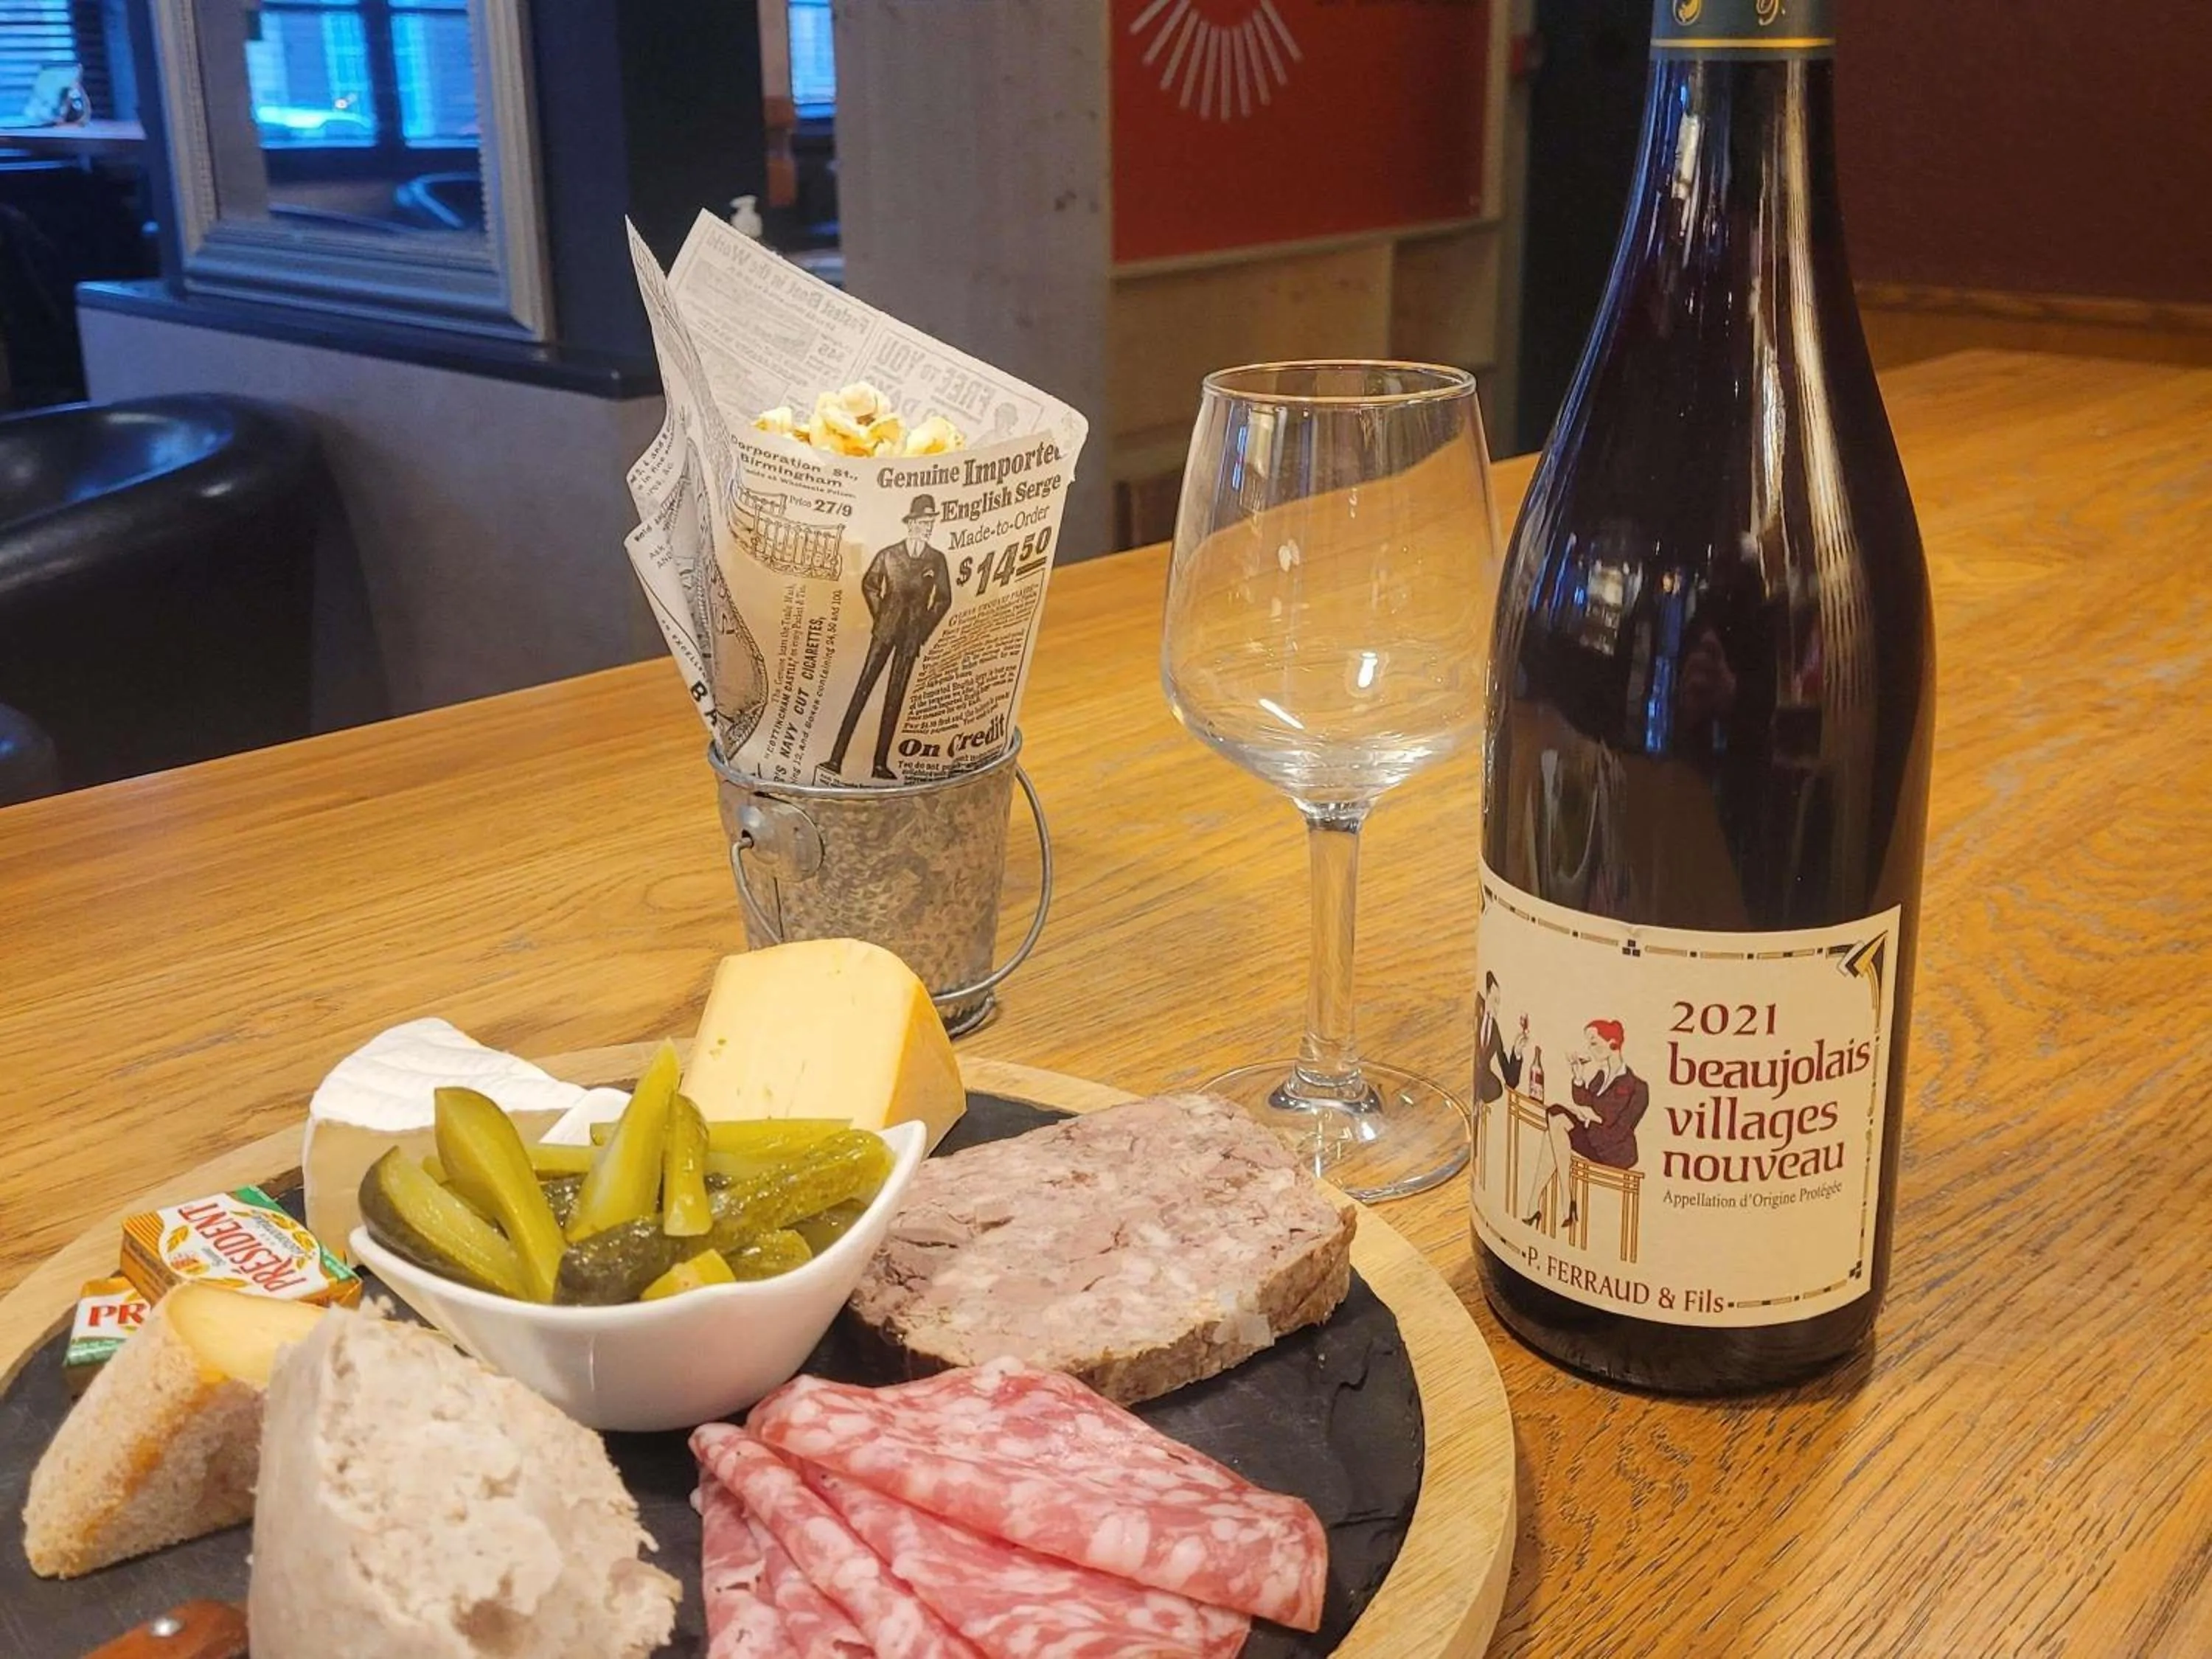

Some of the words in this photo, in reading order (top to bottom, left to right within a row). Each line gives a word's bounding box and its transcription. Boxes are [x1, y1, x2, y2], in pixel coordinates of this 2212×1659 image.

[740, 452, 843, 487] Birmingham
[877, 464, 960, 489] Genuine
[813, 498, 853, 518] 27/9
[940, 485, 1014, 524] English
[1015, 473, 1062, 505] Serge
[947, 505, 1051, 551] Made-to-Order
[801, 616, 827, 681] CIGARETTES,
[793, 686, 810, 715] CUT
[779, 722, 798, 759] NAVY
[897, 738, 942, 758] On
[947, 712, 1006, 759] Credit
[1668, 1000, 1778, 1037] 2021
[1666, 1037, 1872, 1102] beaujolais
[1663, 1094, 1840, 1153] villages
[1661, 1141, 1846, 1184] nouveau
[1663, 1189, 1737, 1210] Appellation
[1739, 1192, 1797, 1211] d'Origine
[1798, 1179, 1843, 1203] Protégée
[177, 1202, 307, 1293] PRÉSIDENT
[1526, 1245, 1542, 1272] P.
[1546, 1254, 1651, 1306] FERRAUD
[1658, 1285, 1677, 1311] &
[1683, 1287, 1725, 1315] Fils
